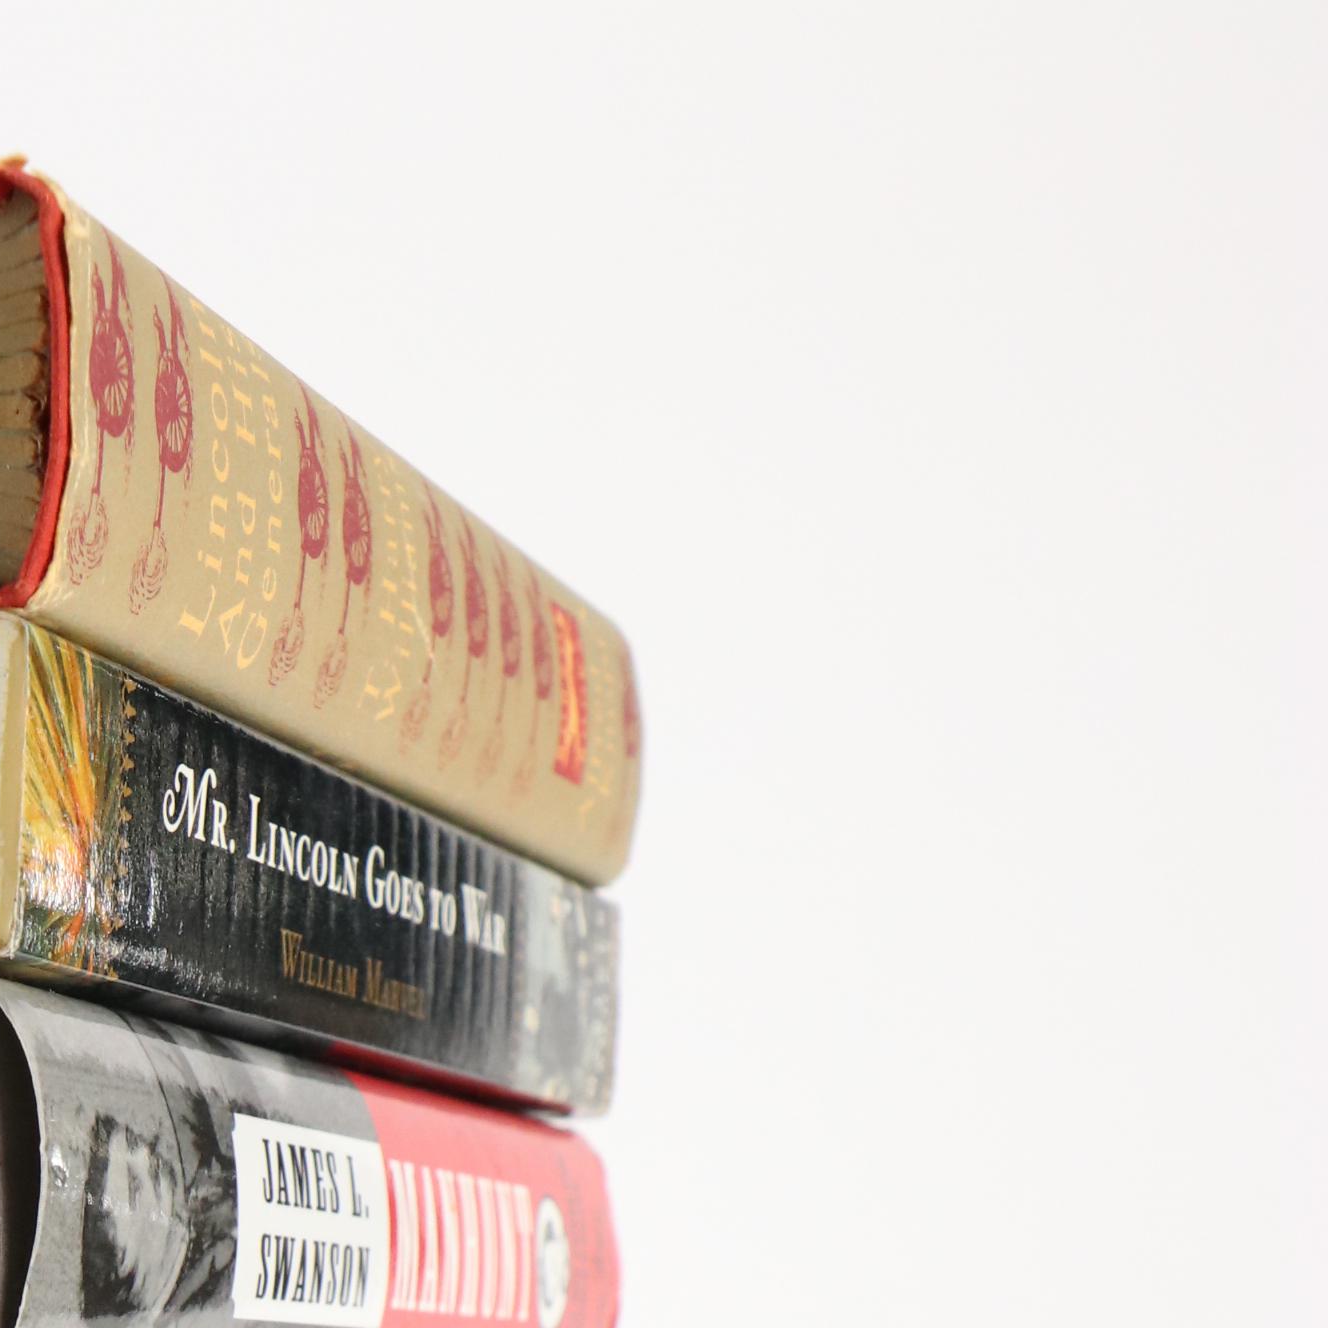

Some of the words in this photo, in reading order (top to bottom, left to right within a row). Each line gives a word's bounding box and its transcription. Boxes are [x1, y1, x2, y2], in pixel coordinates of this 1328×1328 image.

[178, 299, 229, 638] Lincoln
[235, 338, 283, 672] Generals
[219, 492, 256, 655] And
[262, 1139, 340, 1214] JAMES
[346, 1155, 370, 1218] L.
[388, 1158, 535, 1323] MANHUNT
[255, 1233, 371, 1308] SWANSON
